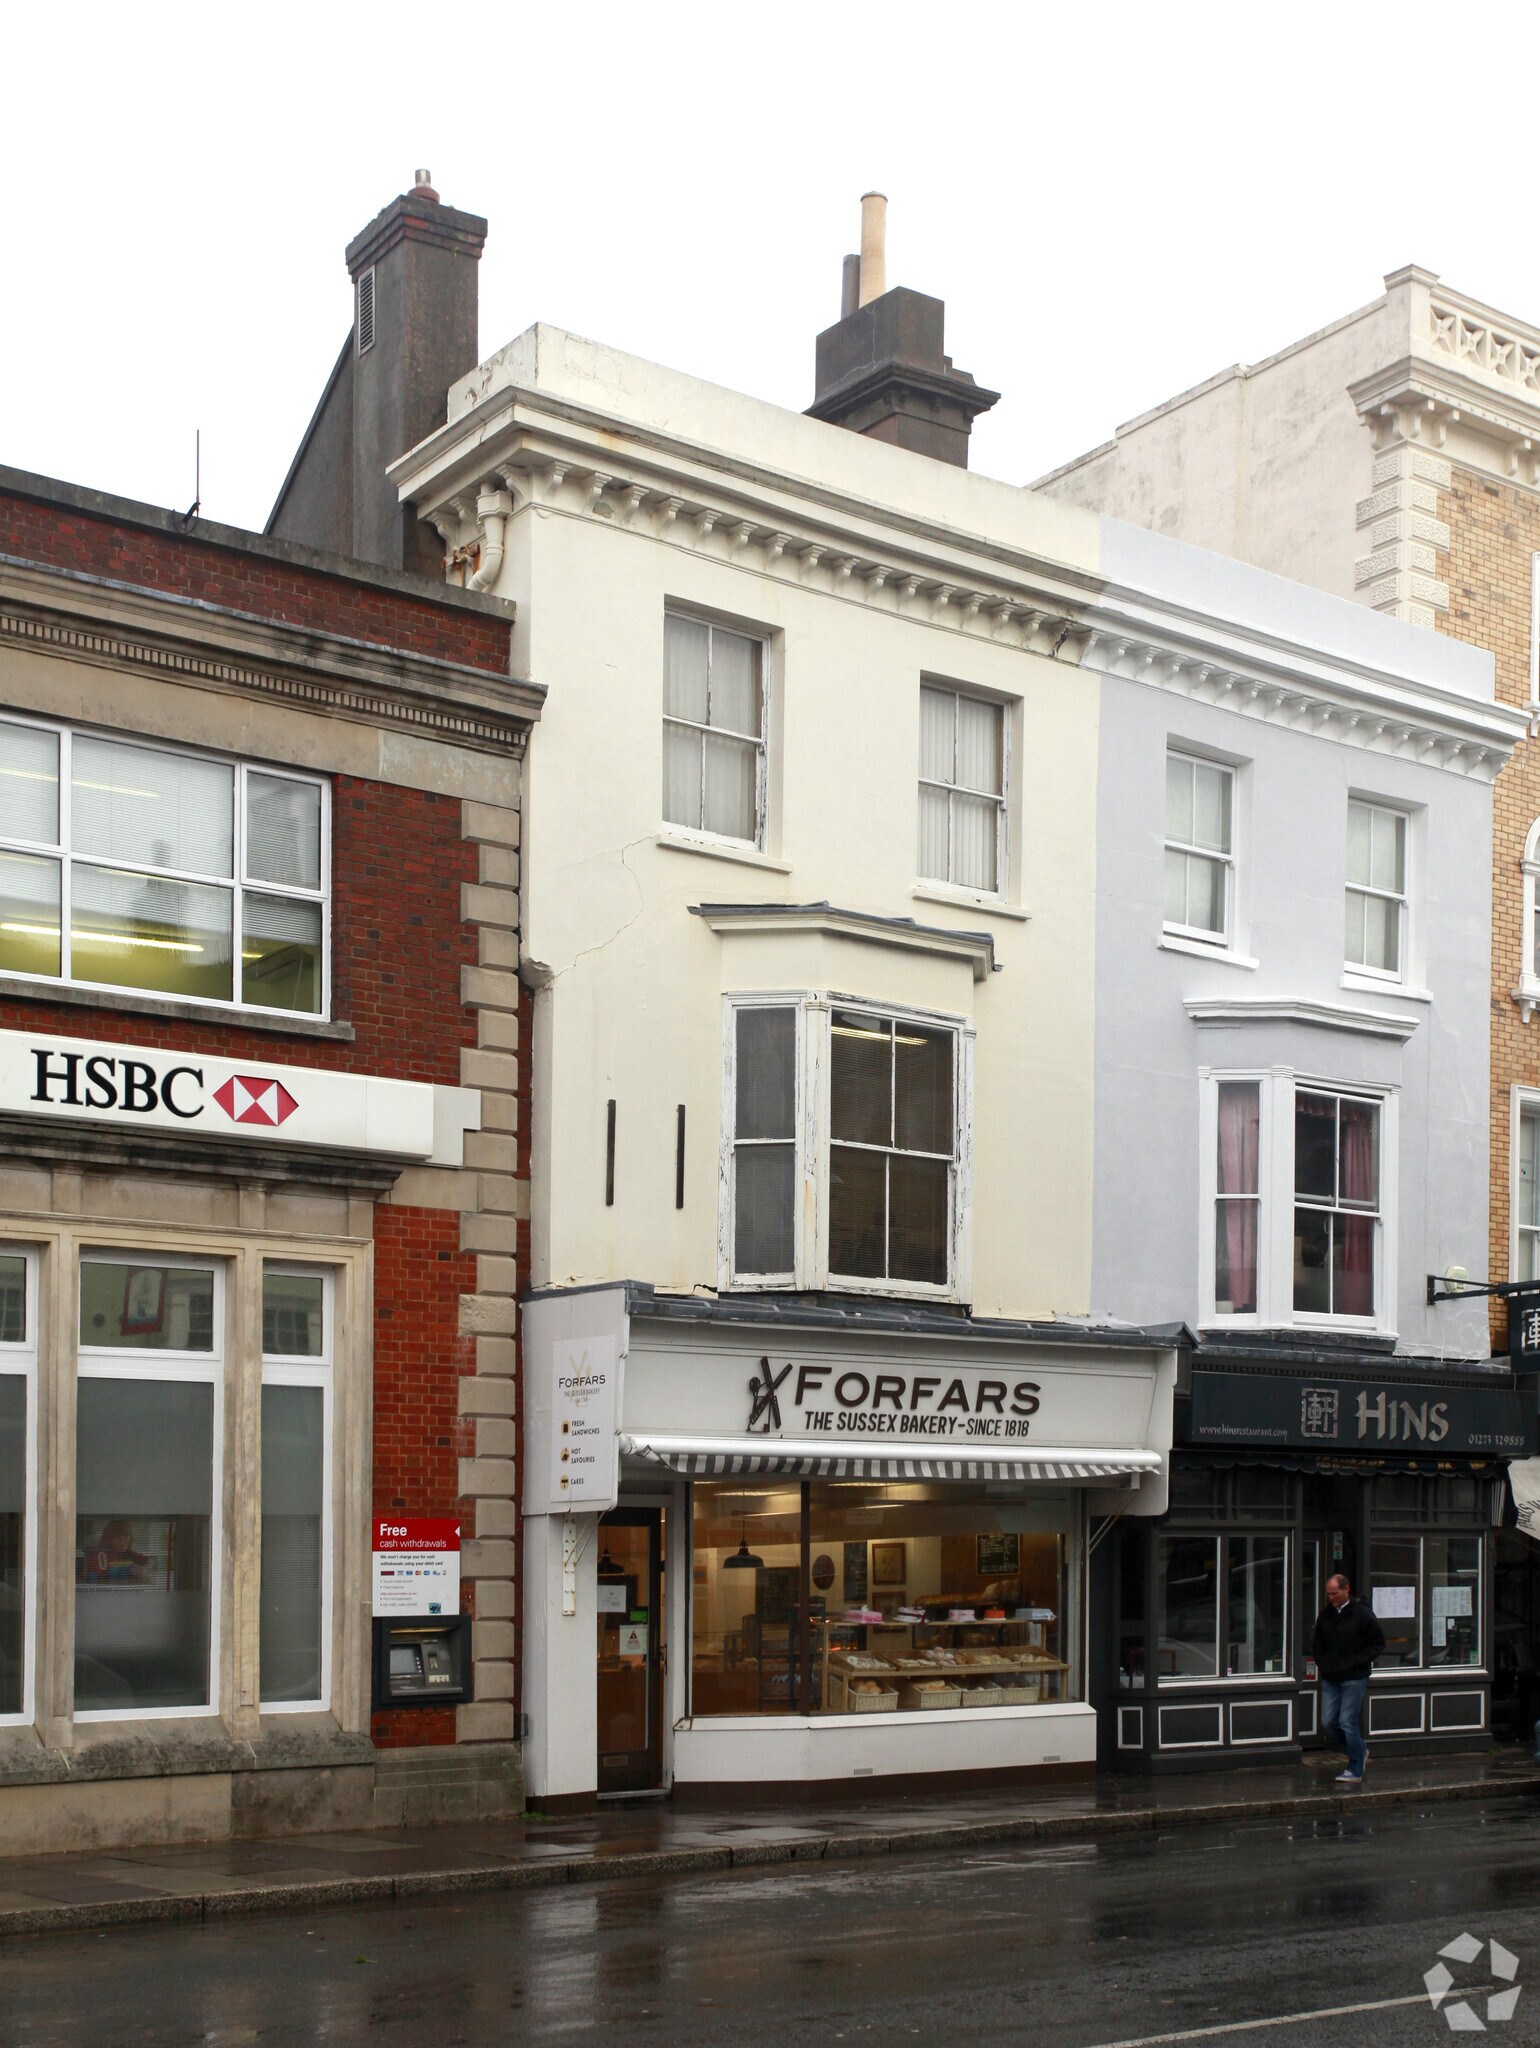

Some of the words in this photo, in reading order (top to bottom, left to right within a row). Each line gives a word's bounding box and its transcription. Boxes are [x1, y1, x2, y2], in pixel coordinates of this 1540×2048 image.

[30, 1049, 205, 1118] HSBC
[558, 1374, 606, 1389] FORFARS
[795, 1365, 1041, 1416] FORFARS
[1355, 1390, 1449, 1442] HINS
[804, 1410, 834, 1431] THE
[836, 1412, 898, 1433] SUSSEX
[1005, 1419, 1030, 1437] 1818
[1199, 1423, 1288, 1437] www.hinsrestaurant.com
[571, 1427, 600, 1437] SANDWICHES
[1468, 1434, 1492, 1445] 01273
[570, 1447, 581, 1455] HOT
[570, 1456, 596, 1464] SAVOURIES
[379, 1523, 408, 1537] Free
[379, 1539, 398, 1548] cash
[399, 1538, 447, 1548] withdrawals
